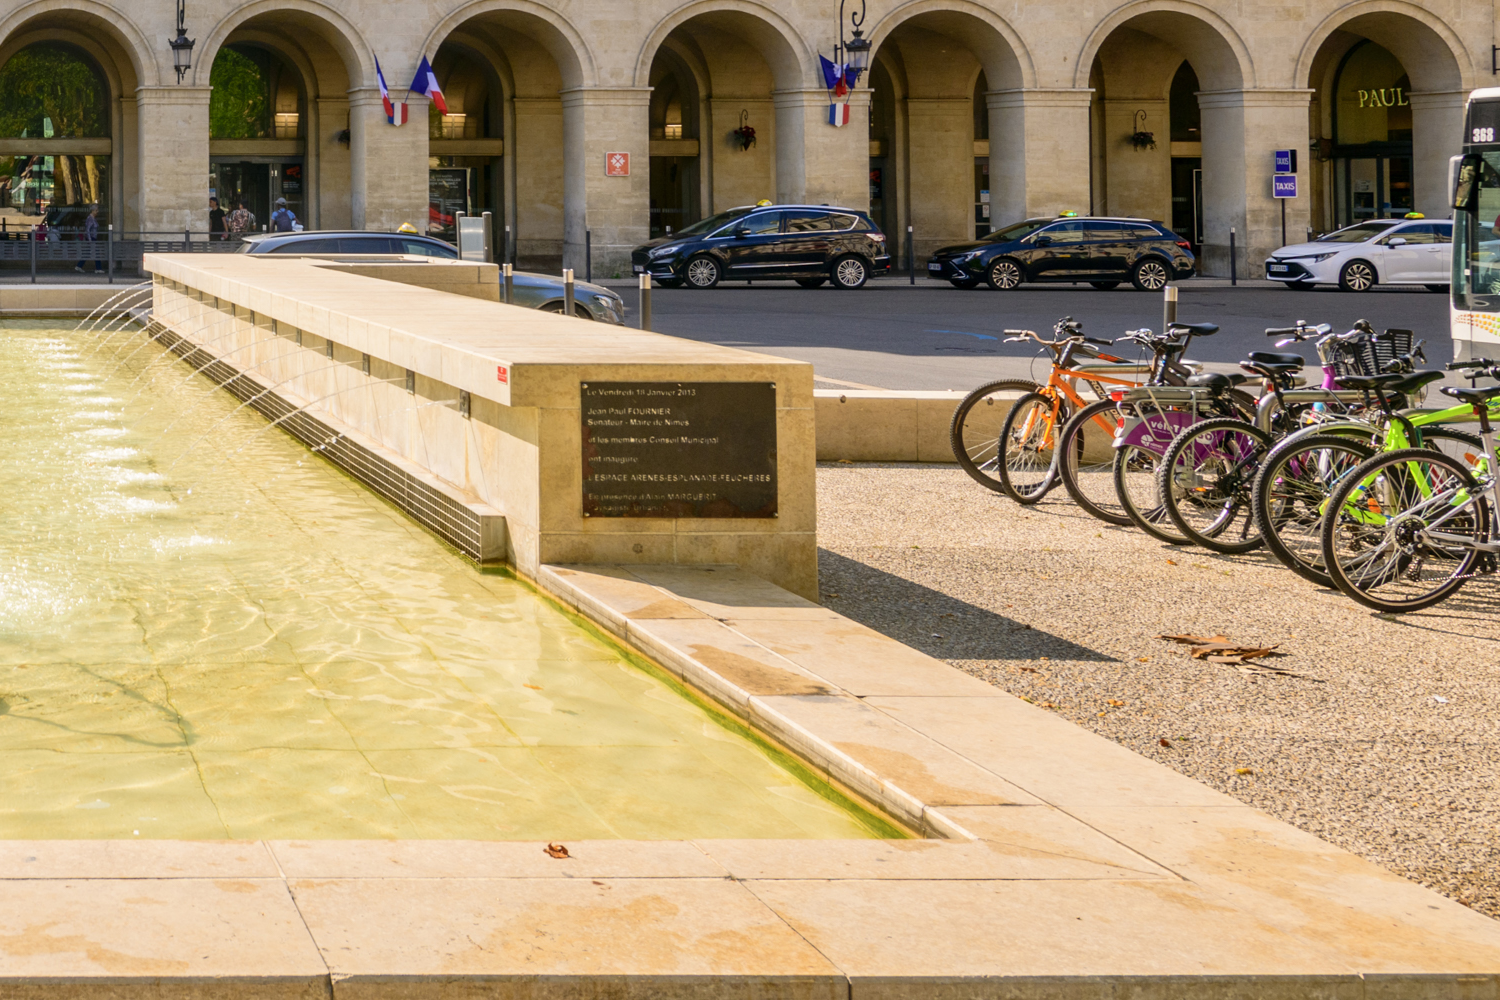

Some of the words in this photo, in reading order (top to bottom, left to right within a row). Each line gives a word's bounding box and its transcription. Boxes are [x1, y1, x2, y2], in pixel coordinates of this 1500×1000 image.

[1358, 88, 1409, 108] PAUL
[1472, 127, 1494, 142] 368
[680, 436, 719, 445] Municipal
